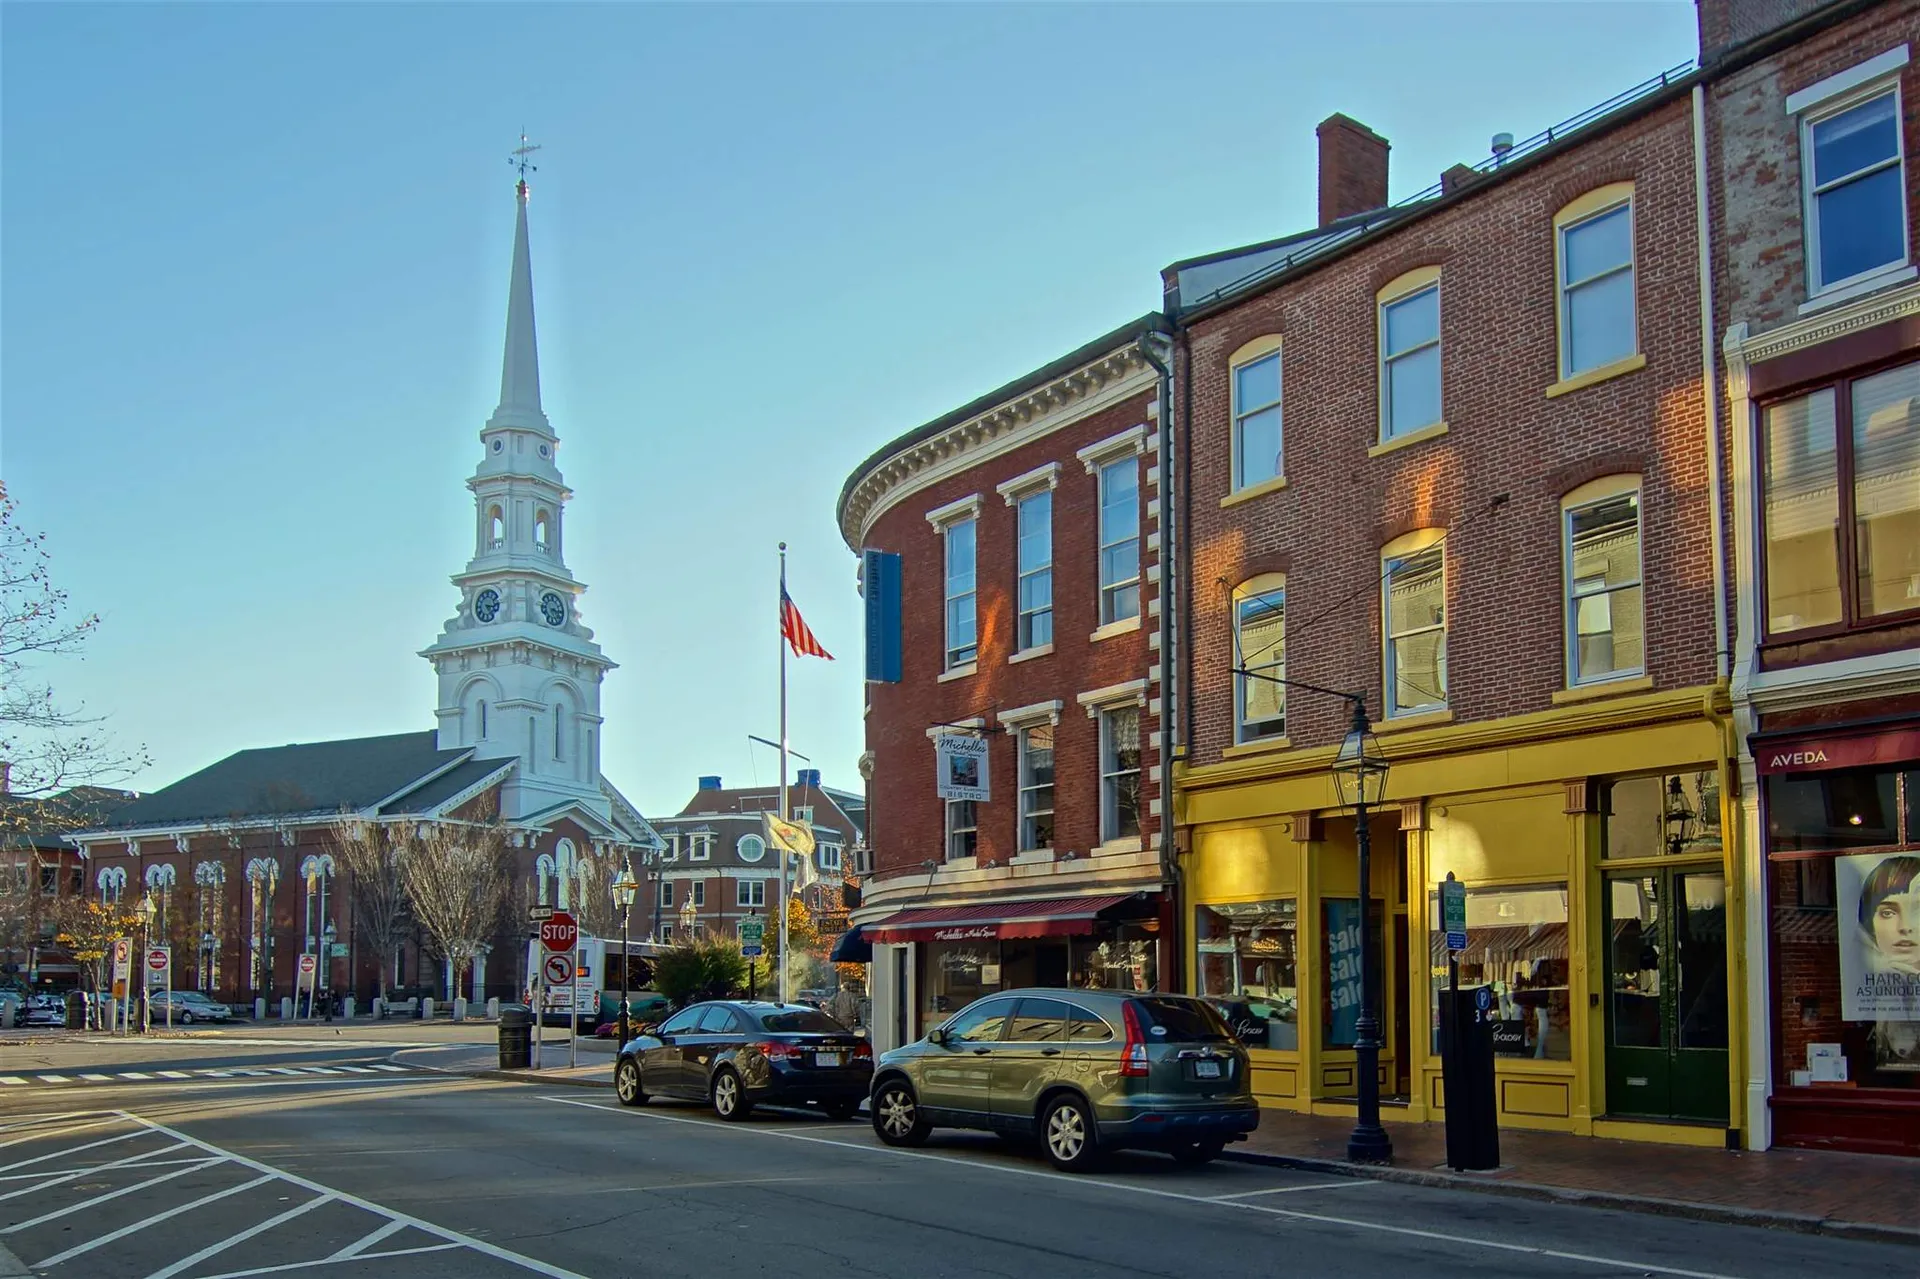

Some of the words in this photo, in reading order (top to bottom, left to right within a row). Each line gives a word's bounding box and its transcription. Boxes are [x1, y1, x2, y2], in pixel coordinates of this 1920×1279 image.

[939, 738, 987, 753] Michelle's
[1770, 750, 1827, 768] AVEDA
[946, 791, 982, 800] BISTRO
[542, 925, 576, 940] STOP
[1865, 973, 1901, 986] HAIR
[1856, 986, 1872, 997] AS
[1875, 986, 1920, 998] UNIQUE
